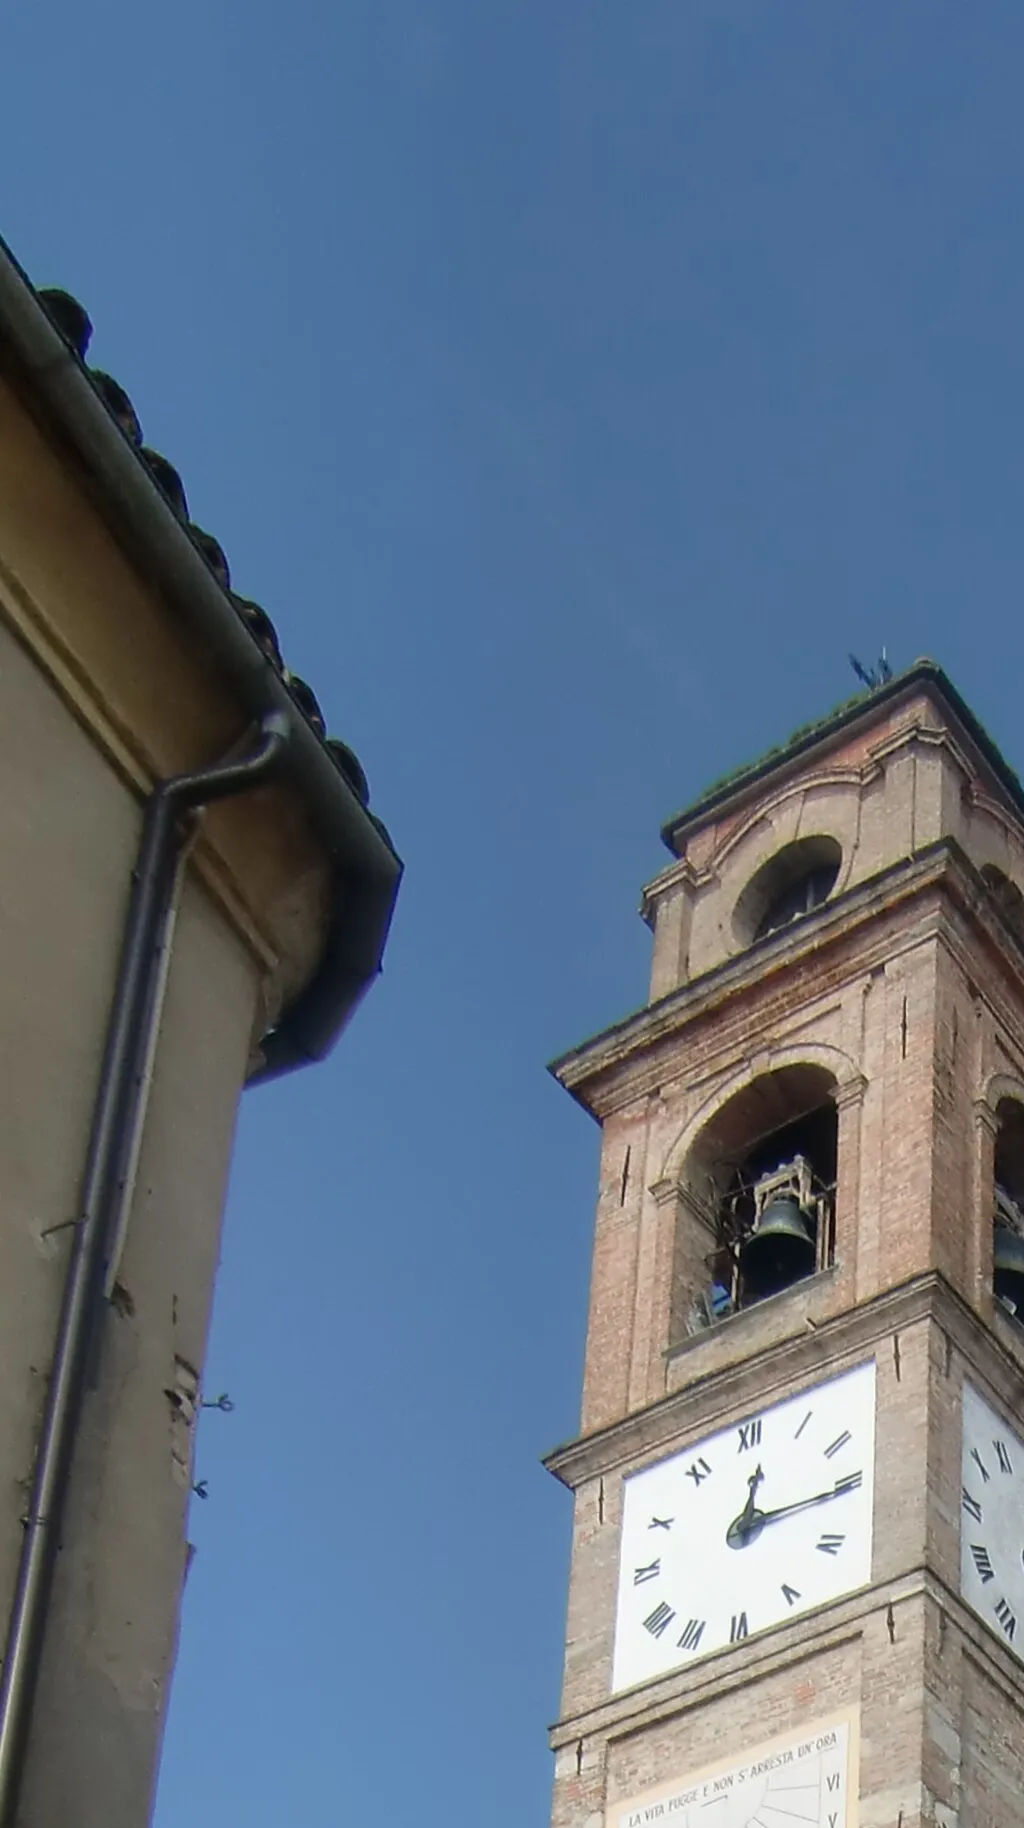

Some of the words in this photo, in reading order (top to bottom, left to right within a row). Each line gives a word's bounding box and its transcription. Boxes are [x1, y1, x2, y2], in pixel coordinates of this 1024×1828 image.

[738, 1419, 762, 1454] XII
[795, 1411, 813, 1440] I
[824, 1430, 852, 1459] II
[992, 1440, 1013, 1475] XI
[685, 1457, 713, 1487] XI
[969, 1447, 991, 1483] X
[962, 1487, 982, 1523] IX
[648, 1516, 675, 1531] X
[633, 1558, 661, 1586] IX
[970, 1543, 995, 1584] VIII
[780, 1583, 802, 1606] V
[642, 1601, 676, 1639] VIII
[676, 1619, 706, 1651] VII
[730, 1611, 749, 1643] VI
[994, 1597, 1017, 1641] VII
[826, 1772, 841, 1793] VI
[628, 1813, 642, 1828] LA
[645, 1804, 664, 1822] VITA
[668, 1788, 699, 1812] FUGGE
[703, 1784, 708, 1797] E
[713, 1774, 734, 1793] NON
